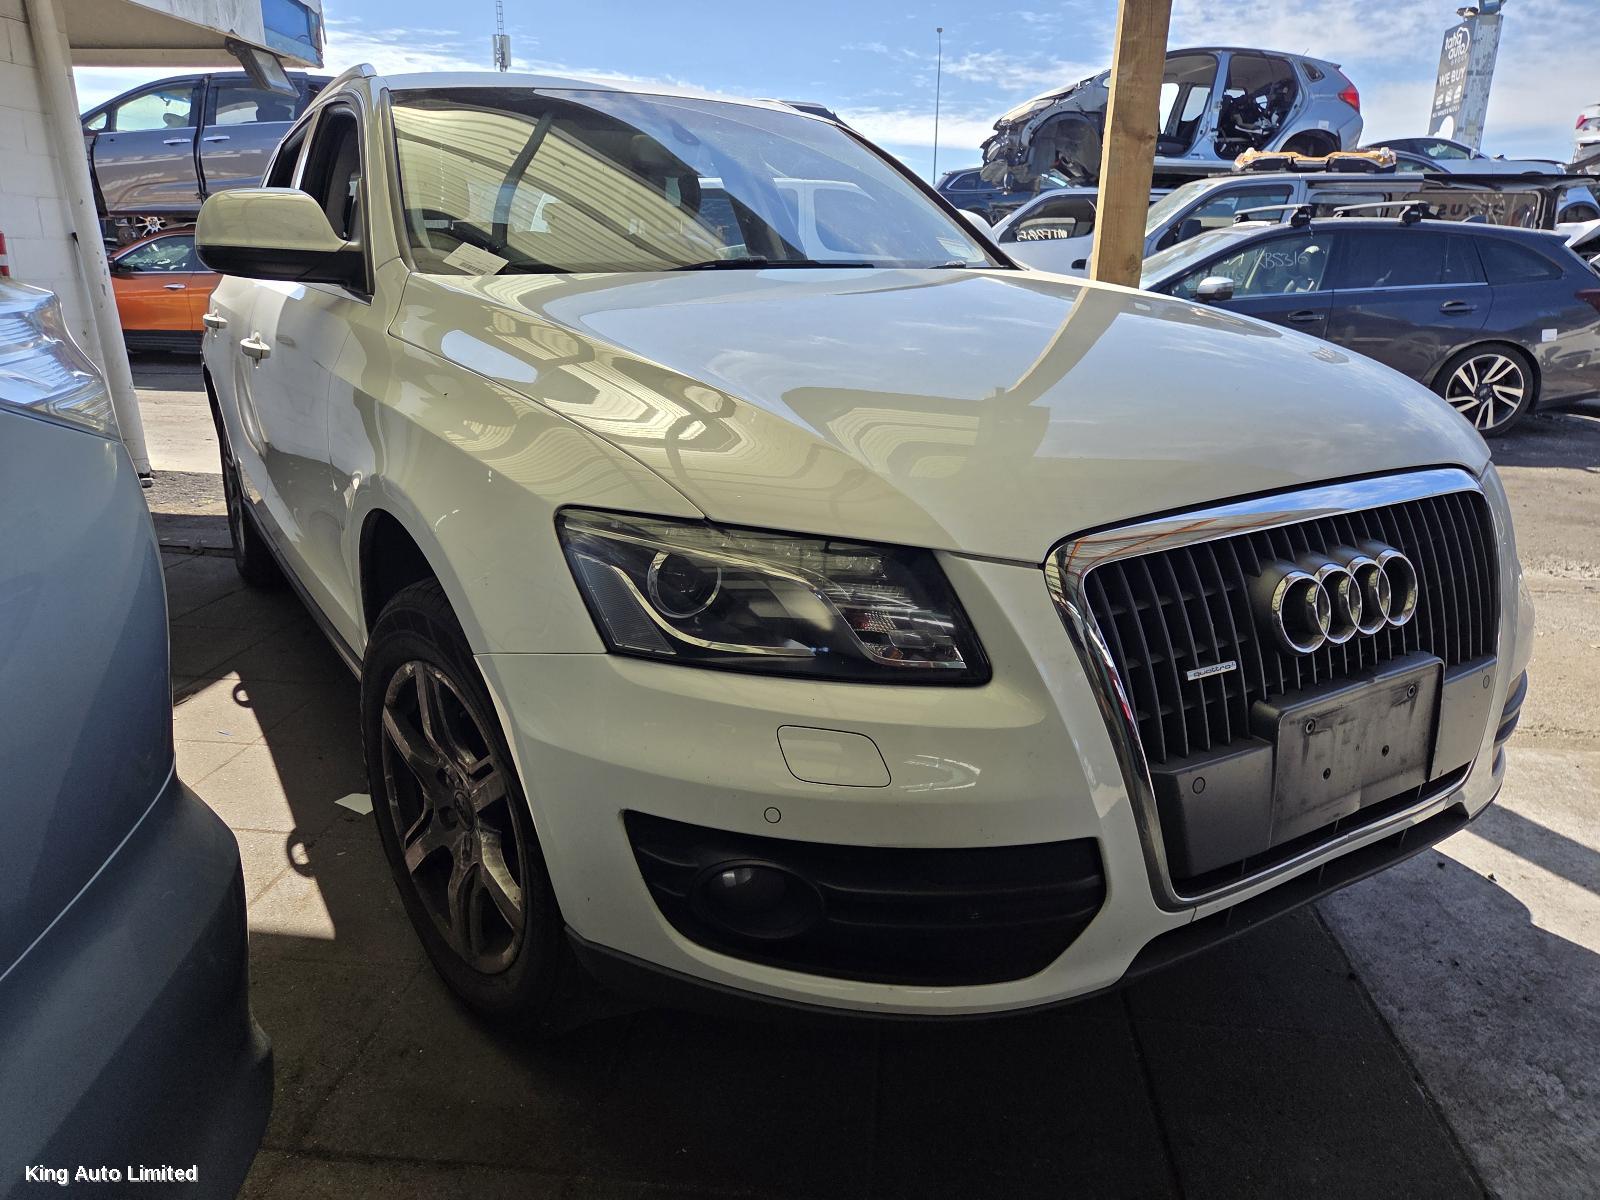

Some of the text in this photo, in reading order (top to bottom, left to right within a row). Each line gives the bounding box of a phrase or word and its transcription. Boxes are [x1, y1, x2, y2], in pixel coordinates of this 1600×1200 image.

[1439, 67, 1466, 87] WE BUY
[1193, 663, 1232, 677] quattro
